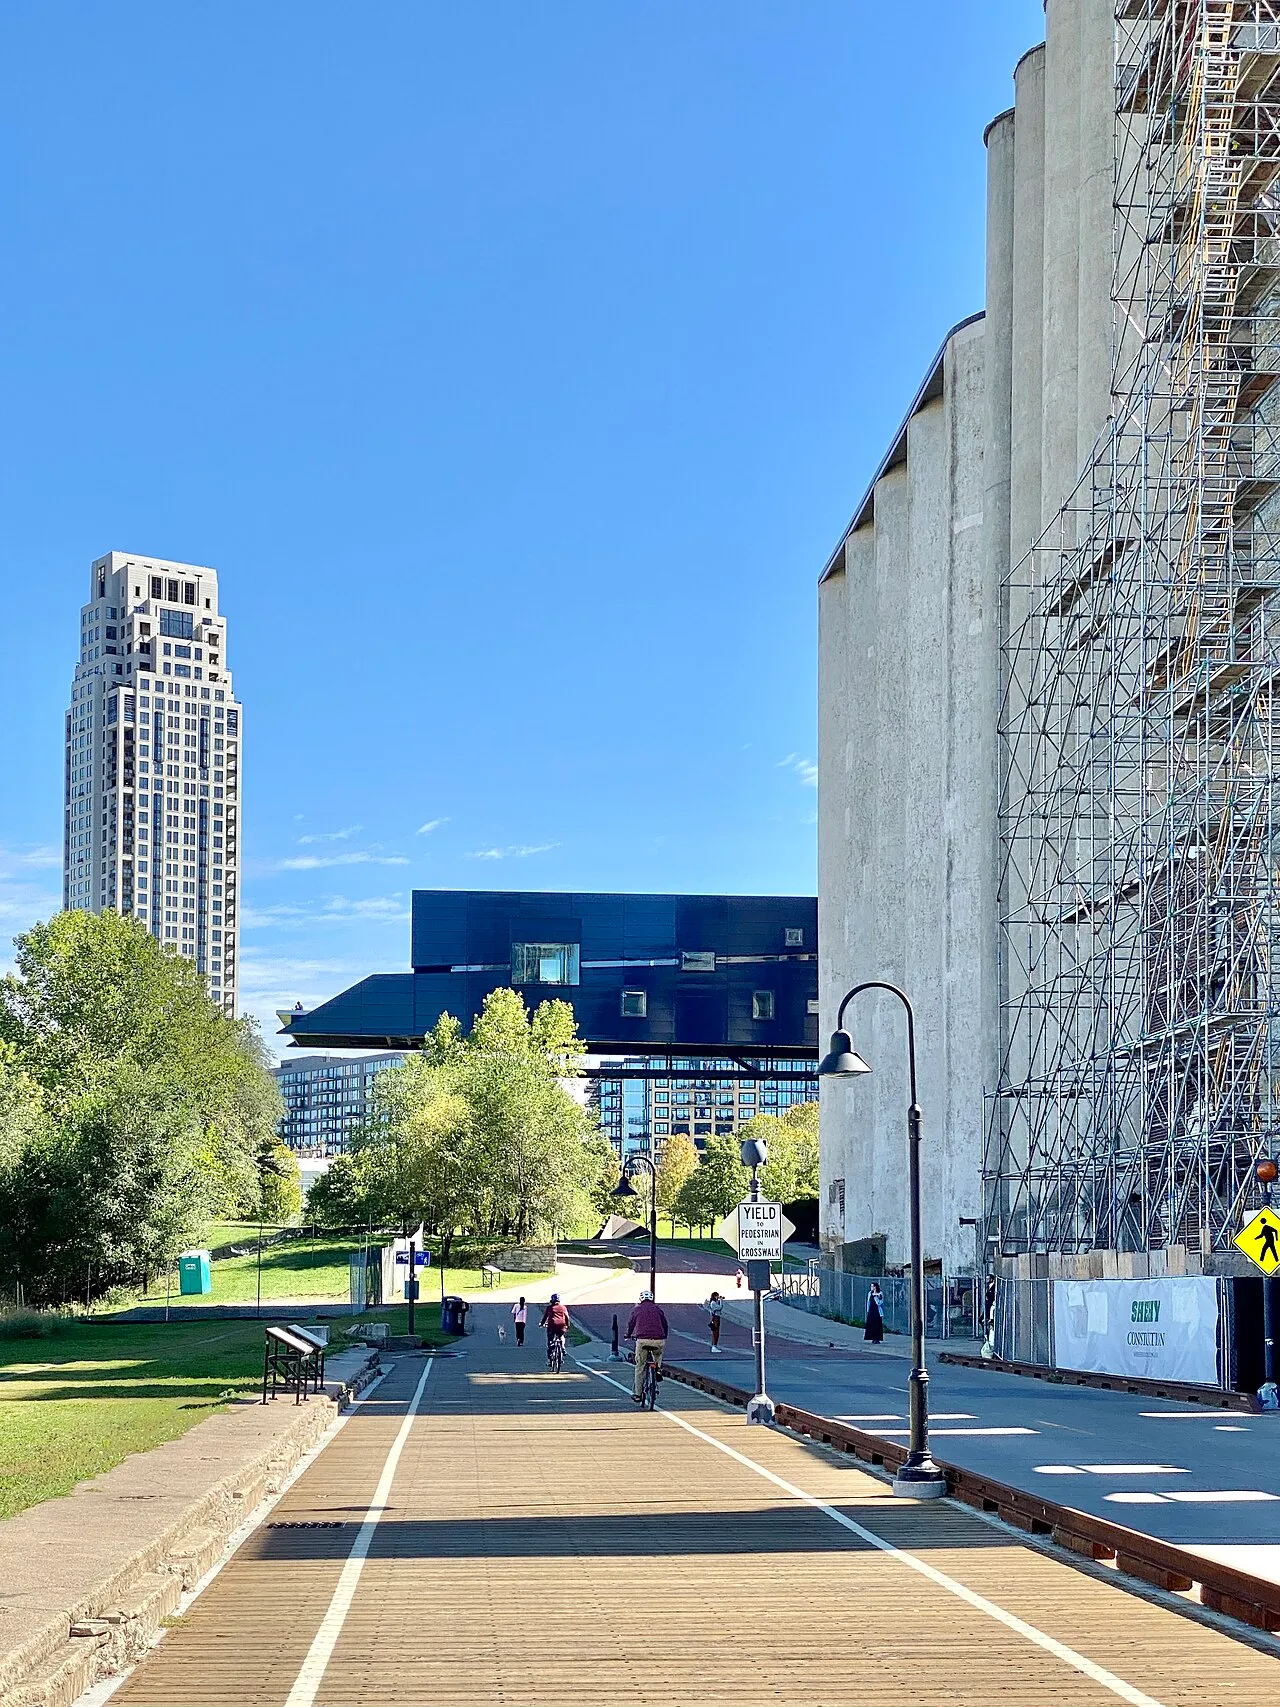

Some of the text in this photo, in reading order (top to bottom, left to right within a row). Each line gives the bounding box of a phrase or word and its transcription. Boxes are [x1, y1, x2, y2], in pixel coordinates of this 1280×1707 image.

[744, 1207, 776, 1219] YIELD
[741, 1229, 779, 1238] PEDESTRIAN
[741, 1248, 780, 1257] CROSSWALK
